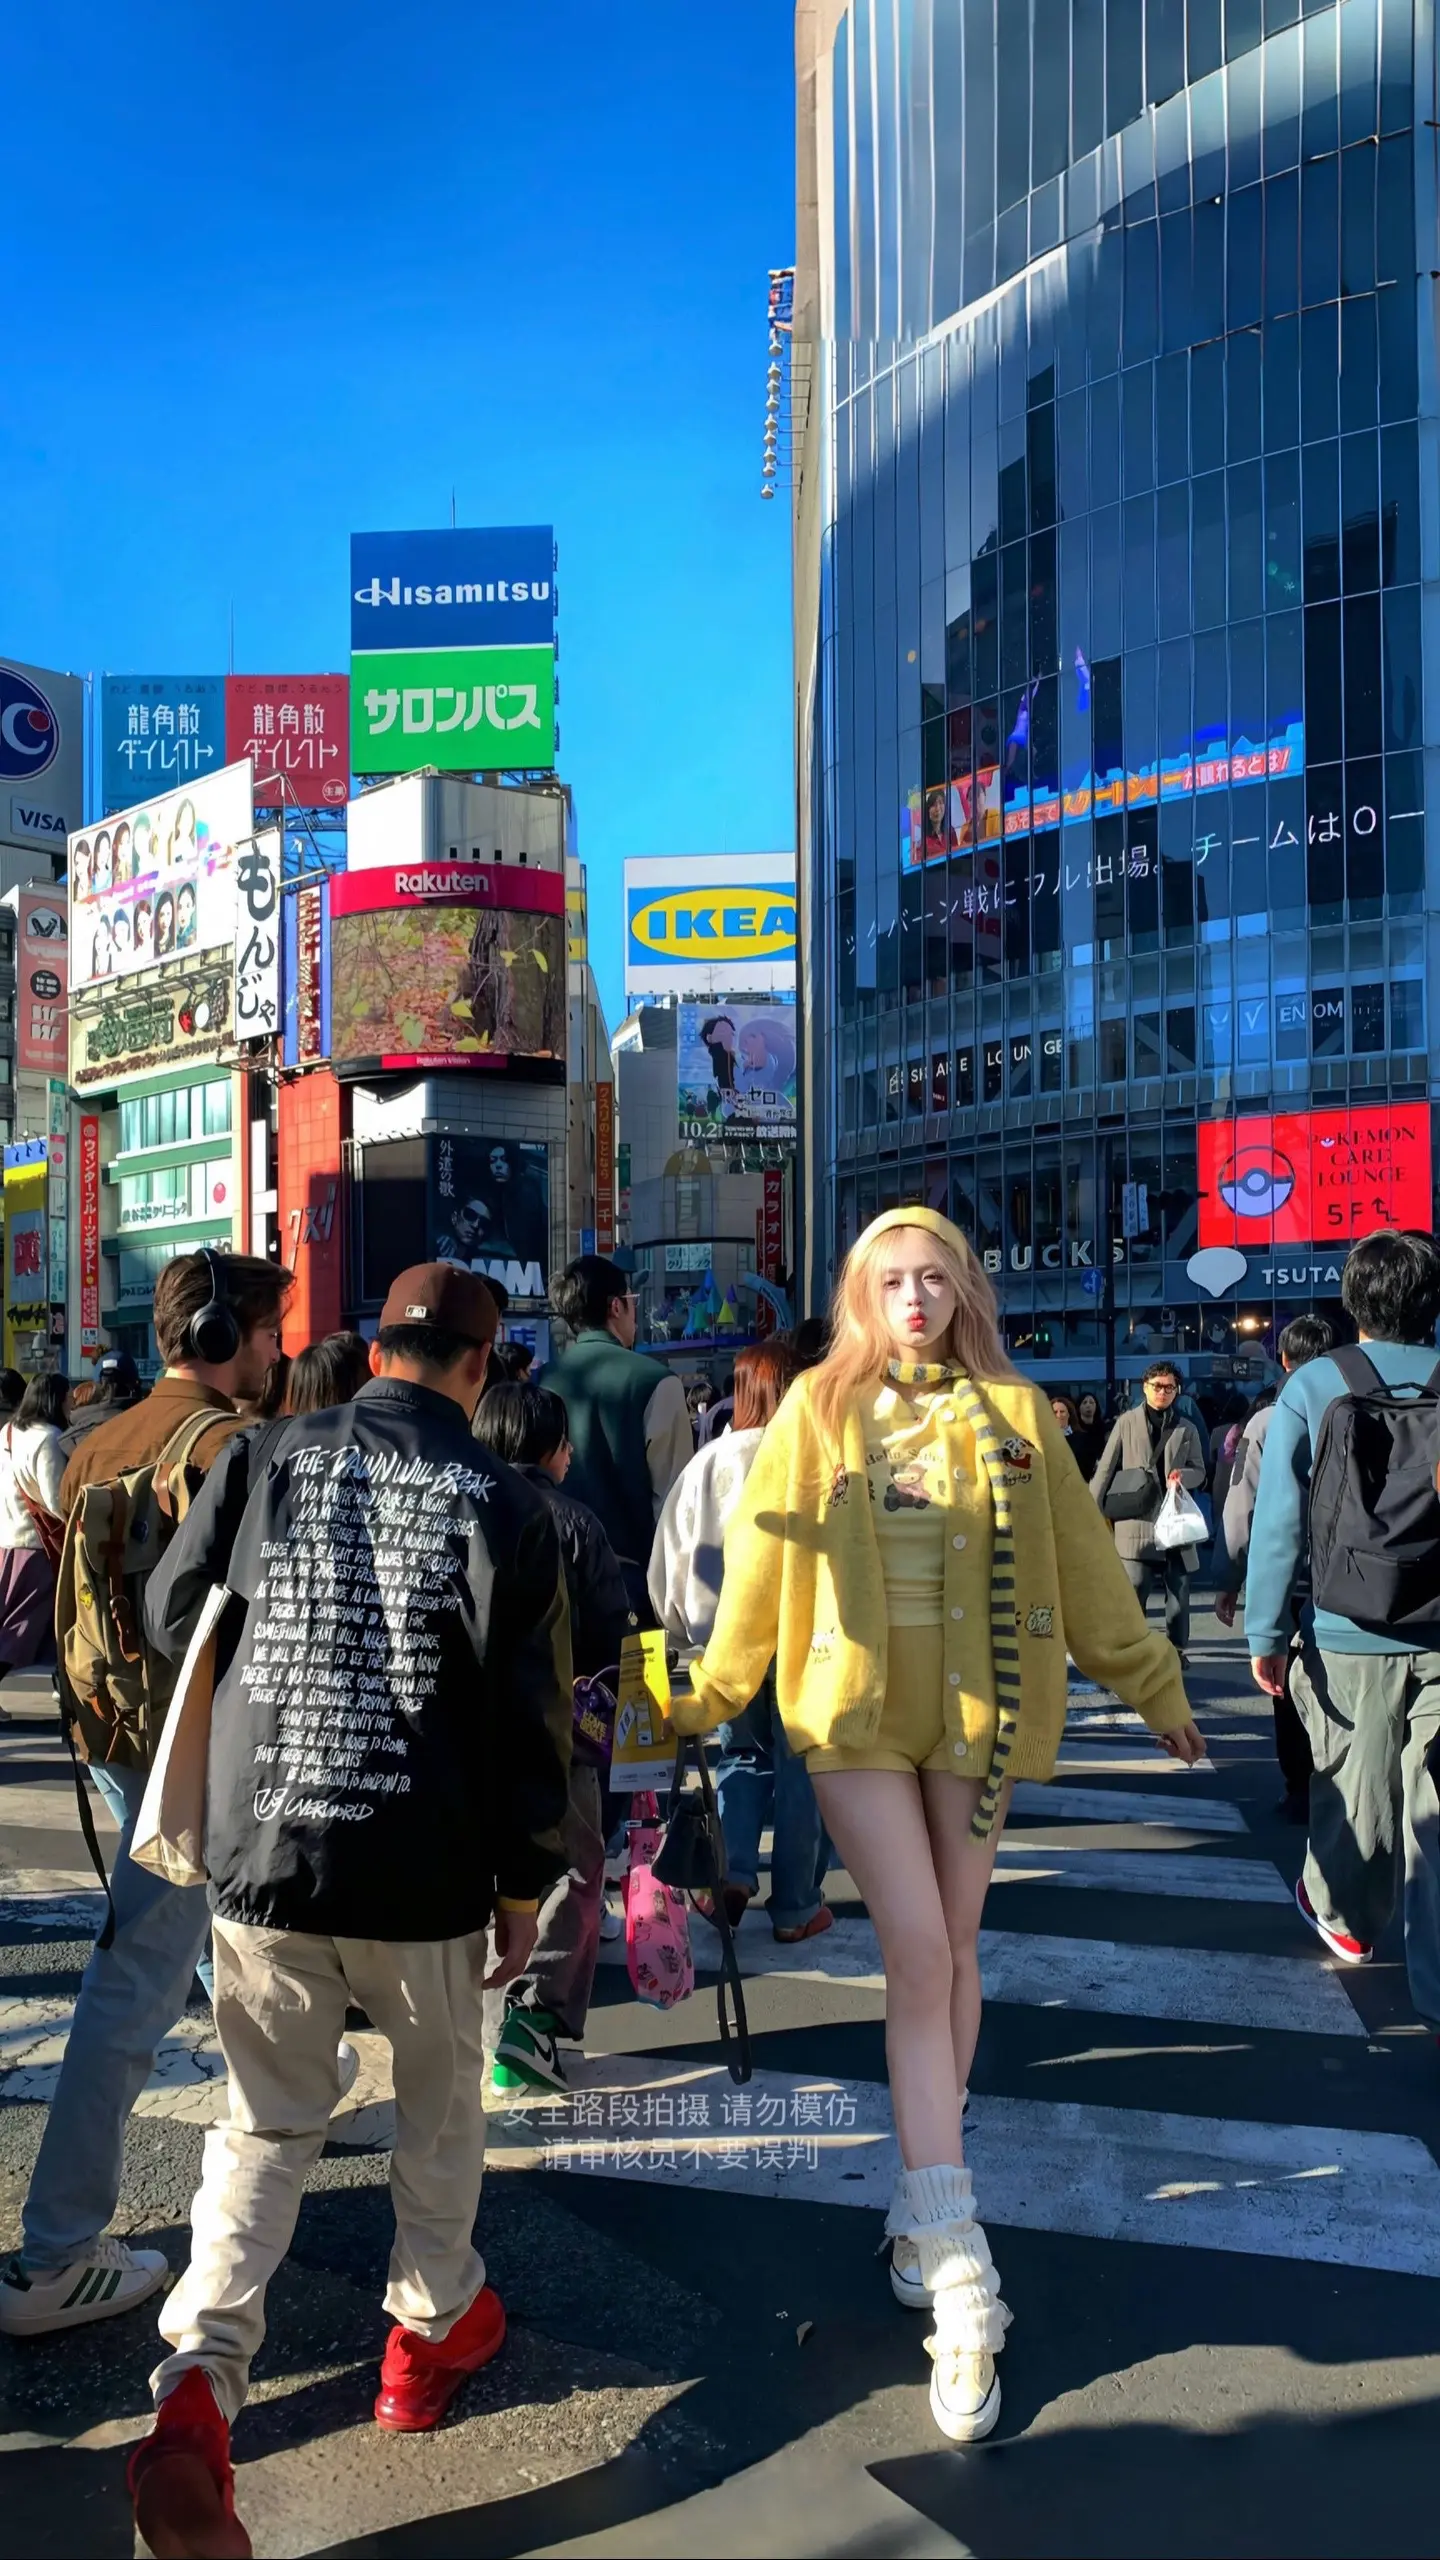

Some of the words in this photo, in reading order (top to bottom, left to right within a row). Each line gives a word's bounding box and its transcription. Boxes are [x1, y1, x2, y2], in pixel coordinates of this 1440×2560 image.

[355, 577, 549, 606] Hisamitsu
[128, 704, 200, 735] 龍角散
[253, 704, 324, 735] 龍角散
[365, 685, 541, 734] サロンパス
[17, 808, 66, 834] VISA
[395, 870, 489, 893] Rakuten
[237, 838, 276, 1028] もんじゃ
[648, 907, 796, 940] IKEA
[683, 1121, 717, 1138] 10.2
[1319, 1167, 1408, 1188] LOUNGE
[436, 1257, 545, 1296] MM
[1262, 1264, 1343, 1286] TSUTA
[288, 1446, 330, 1476] THE
[330, 1446, 398, 1484] DAWN
[393, 1456, 434, 1486] WILL
[293, 1478, 318, 1502] NO
[268, 1602, 297, 1619] THERE
[334, 1649, 346, 1664] TO
[240, 1664, 271, 1686] THERE
[248, 1686, 277, 1704] THERE
